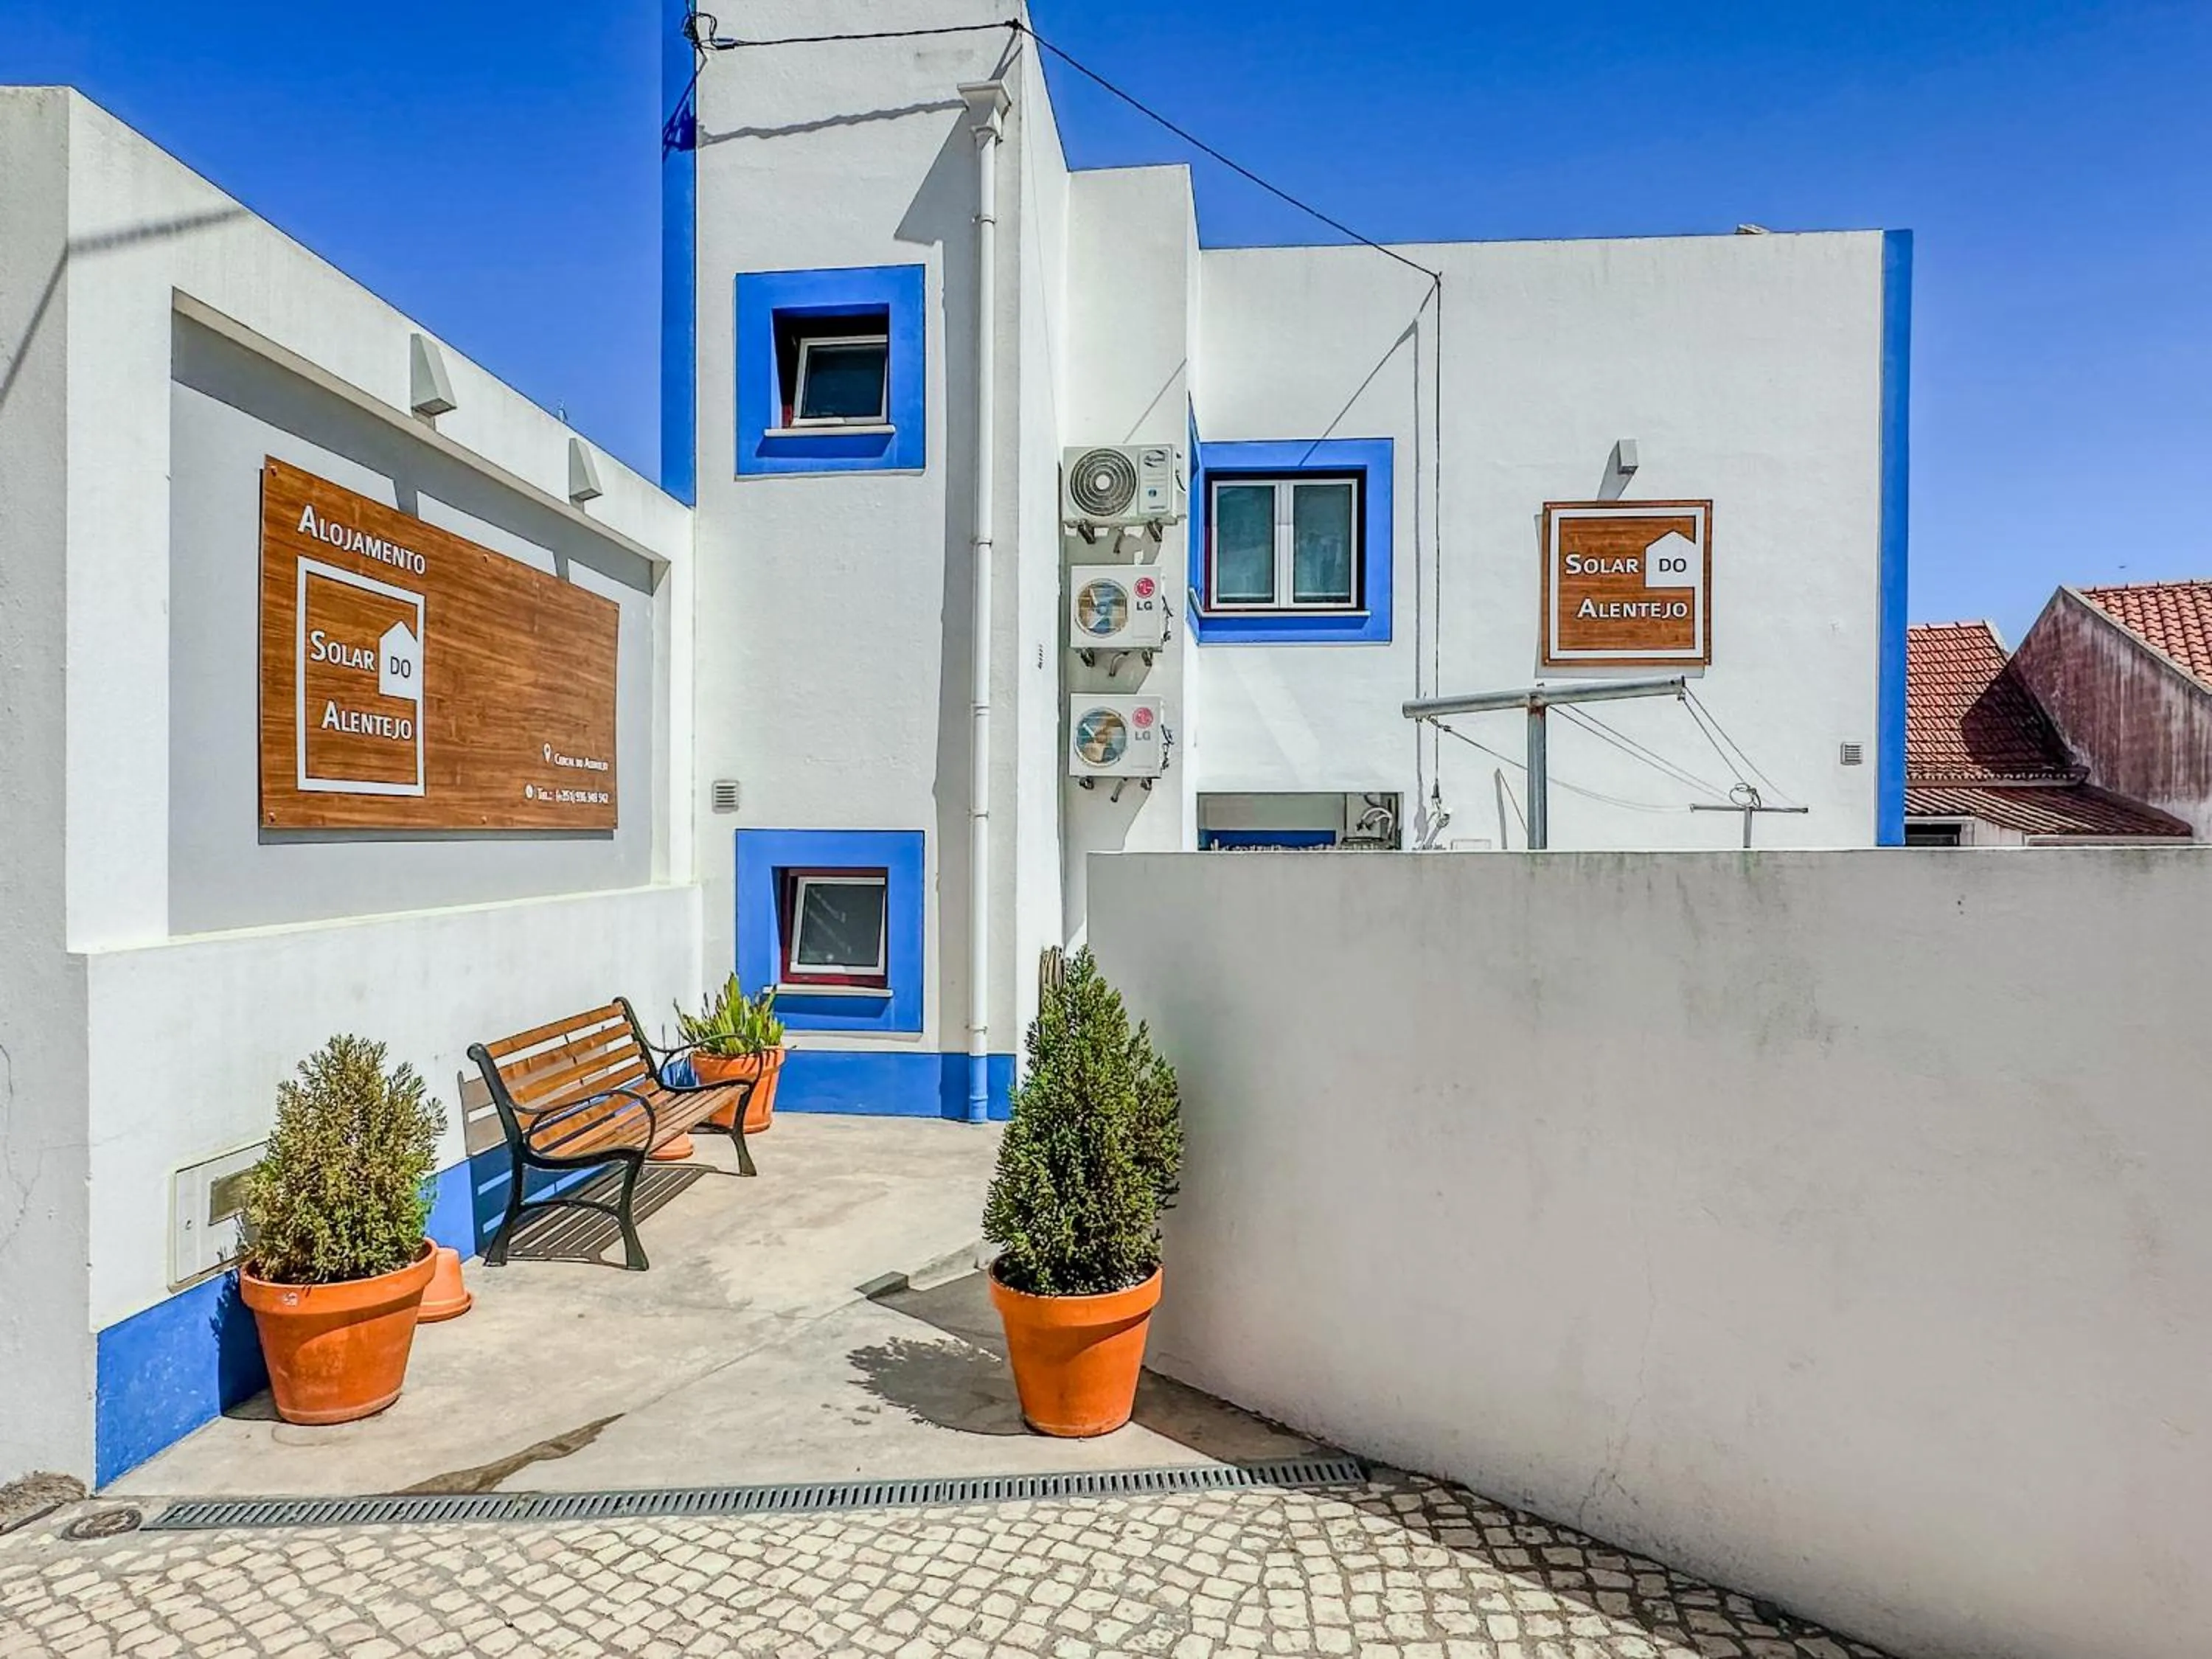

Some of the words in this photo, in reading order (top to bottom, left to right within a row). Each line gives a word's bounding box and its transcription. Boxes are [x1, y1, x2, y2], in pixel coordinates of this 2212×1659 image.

[297, 504, 426, 575] ALOJAMENTO
[1565, 554, 1639, 575] SOLAR
[1658, 558, 1687, 573] DO
[1136, 601, 1152, 611] LG
[1576, 597, 1688, 619] ALENTEJO
[310, 630, 375, 671] SOLAR
[389, 655, 411, 679] DO
[321, 700, 413, 740] ALENTEJO
